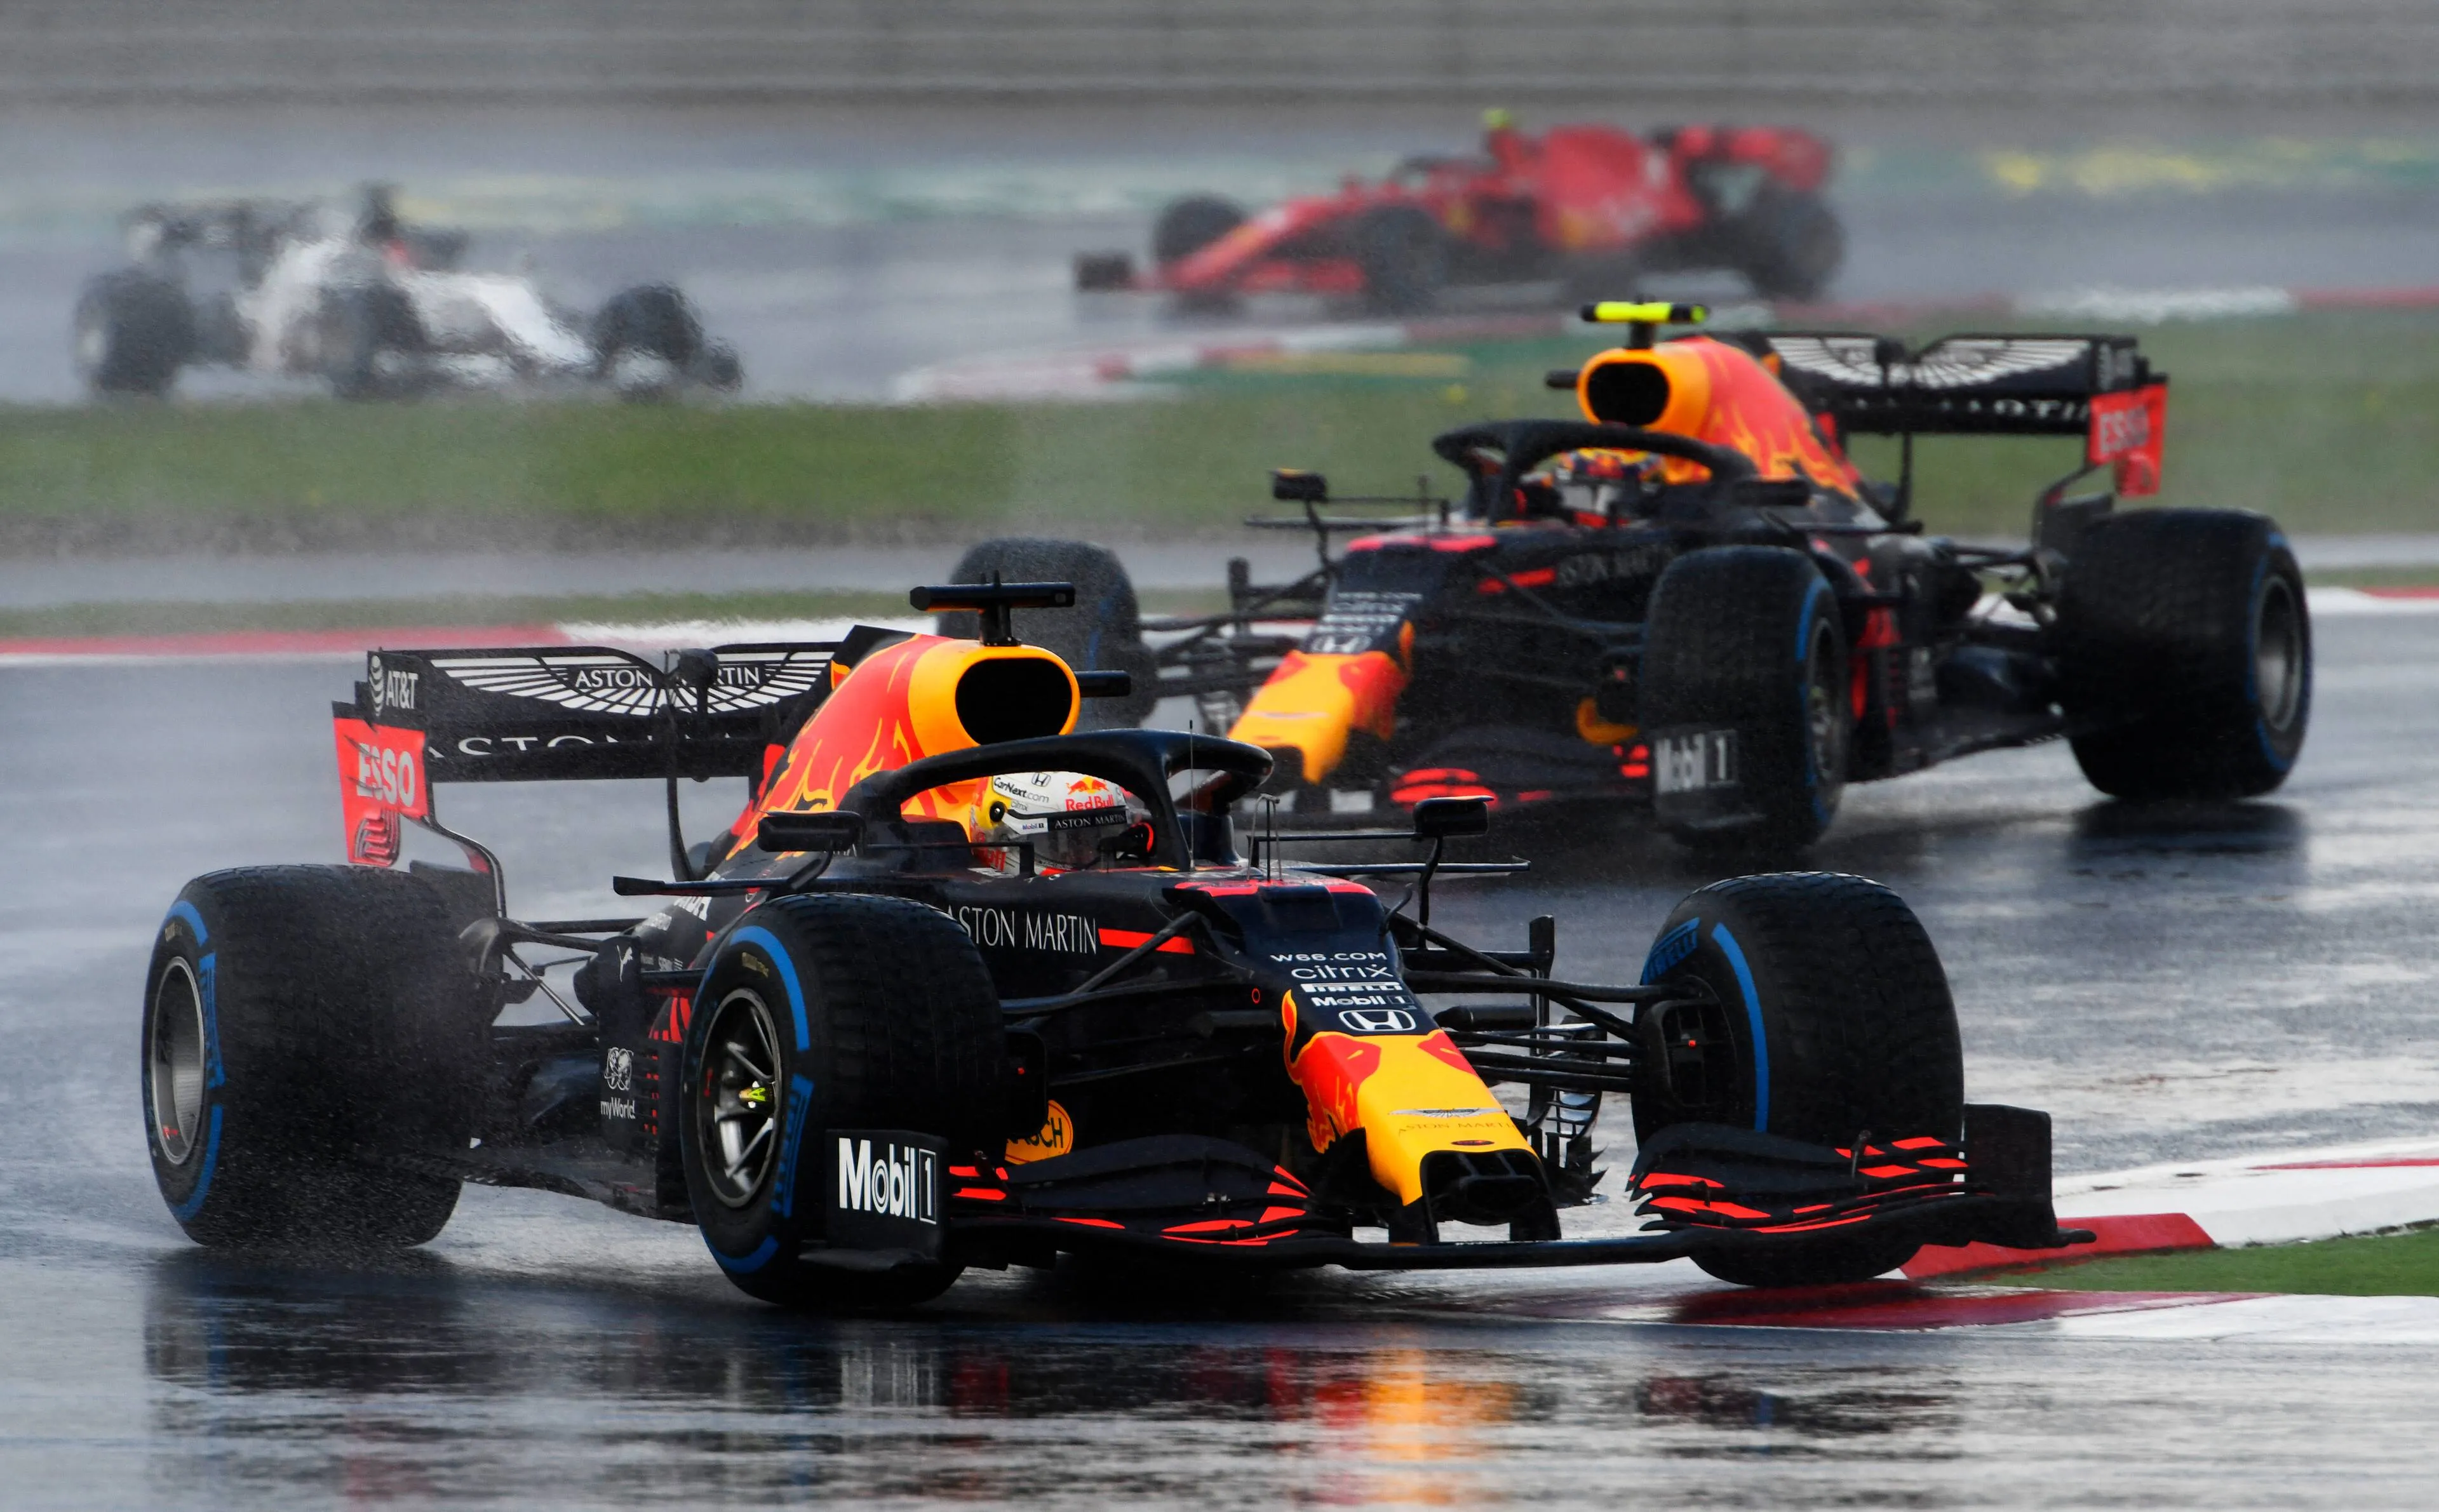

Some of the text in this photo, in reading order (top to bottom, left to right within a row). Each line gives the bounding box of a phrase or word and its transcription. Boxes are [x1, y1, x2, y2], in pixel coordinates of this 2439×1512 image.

[386, 669, 418, 709] AT&T
[575, 669, 653, 688] ASTON
[357, 742, 414, 807] ESSO
[994, 777, 1049, 803] CarNext.com
[1065, 793, 1115, 811] Red Bull
[1054, 813, 1125, 829] ASTON MARTIN
[1025, 911, 1097, 955] MARTIN
[1270, 953, 1388, 962] W66.COM
[1300, 981, 1403, 993] PIRELLI
[1310, 995, 1387, 1007] Mobil
[600, 1097, 636, 1120] myWorld
[838, 1137, 916, 1219] Mobil
